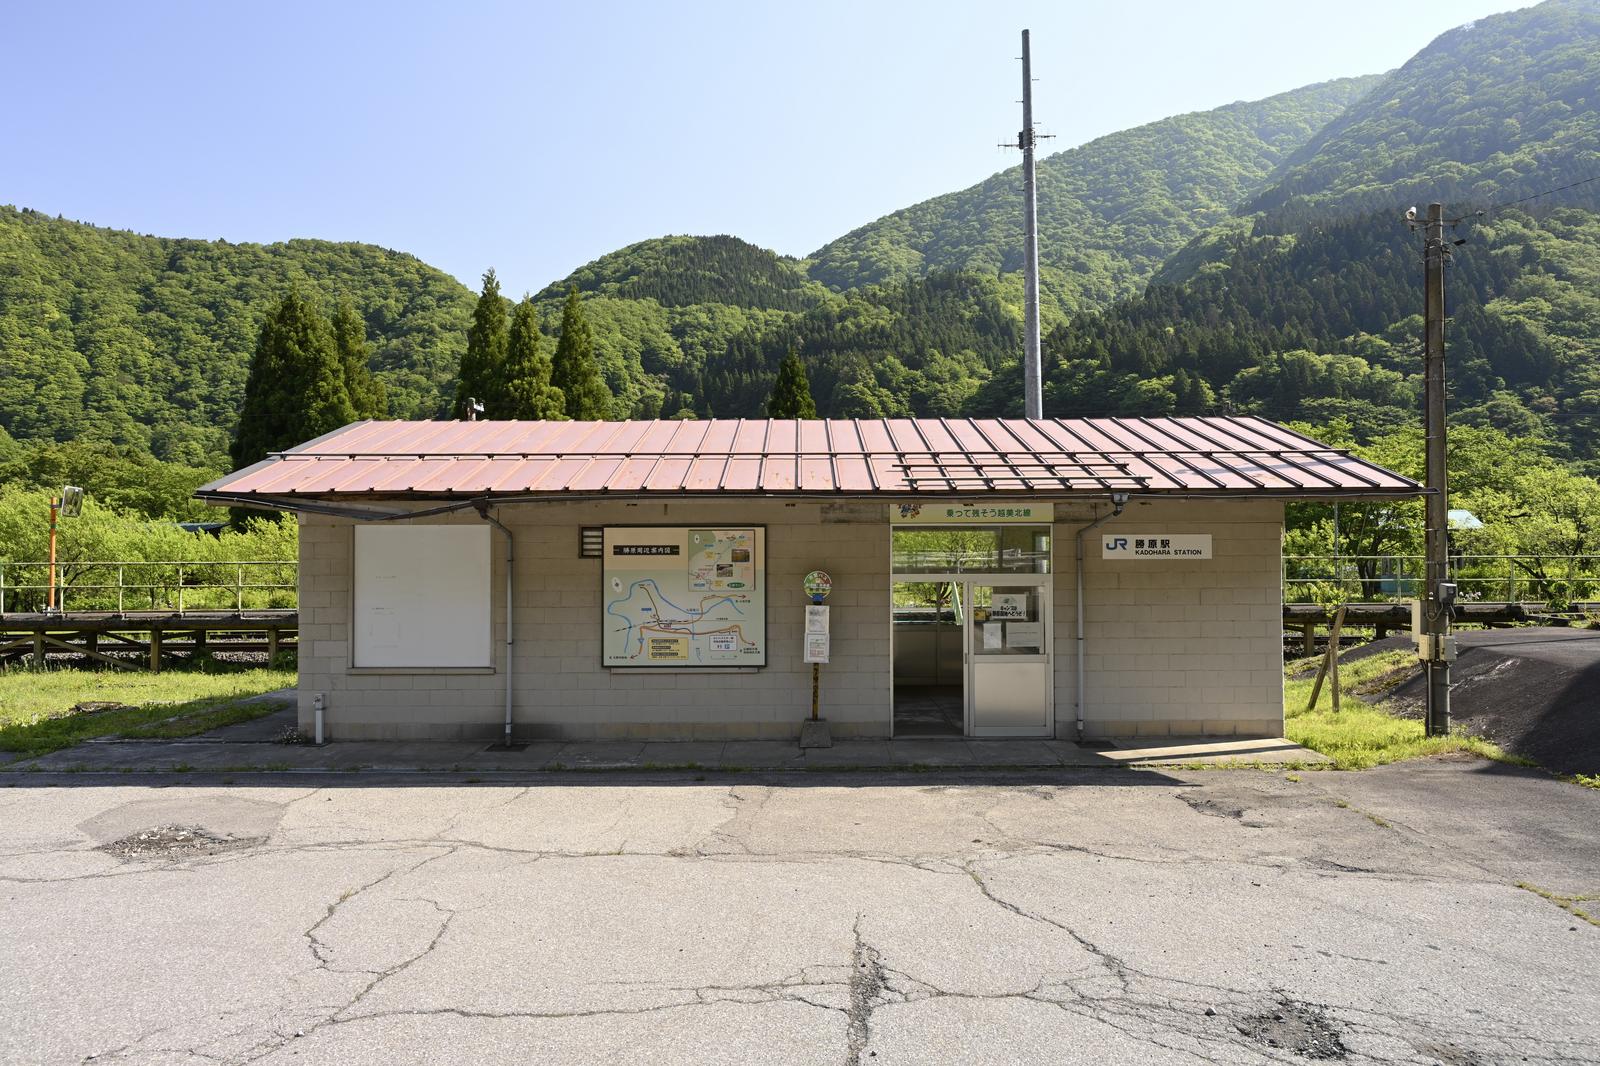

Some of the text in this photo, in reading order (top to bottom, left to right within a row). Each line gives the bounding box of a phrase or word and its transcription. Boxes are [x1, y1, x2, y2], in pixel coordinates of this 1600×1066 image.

[946, 508, 1031, 518] 乗って残そう越美北線
[1105, 538, 1128, 551] JR
[1135, 539, 1170, 549] 勝原駅
